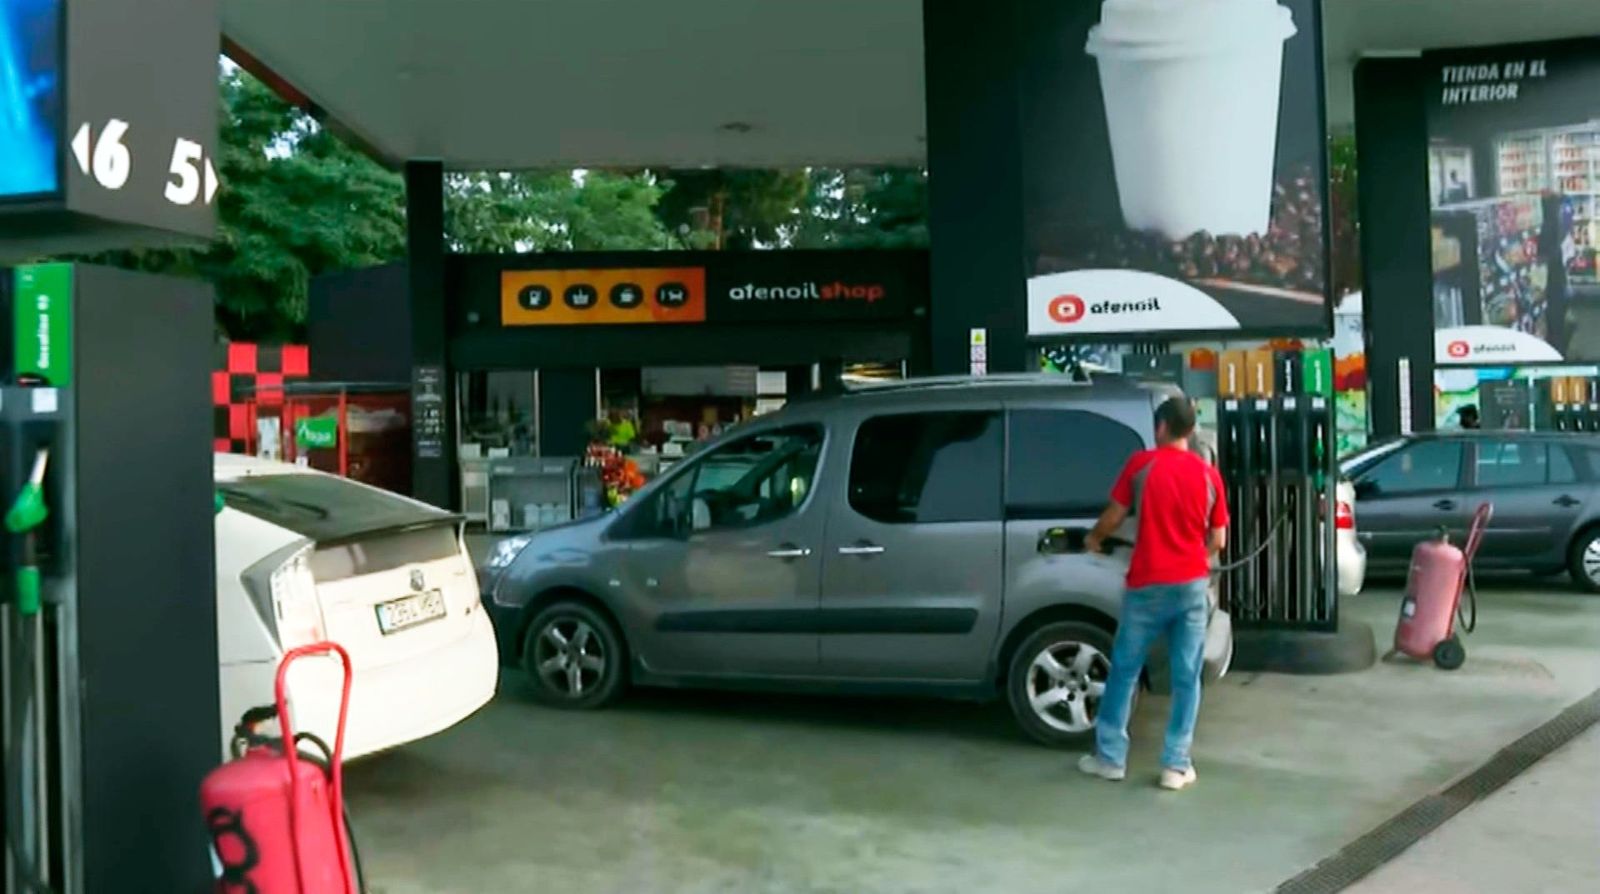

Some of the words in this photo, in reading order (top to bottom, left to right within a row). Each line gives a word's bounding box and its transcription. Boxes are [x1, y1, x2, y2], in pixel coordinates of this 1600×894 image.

[1442, 63, 1499, 82] TIENDA
[1503, 61, 1526, 79] EN
[1529, 60, 1547, 77] EL
[1442, 83, 1518, 104] INTERIOR
[92, 118, 131, 190] 6
[164, 137, 203, 205] 5
